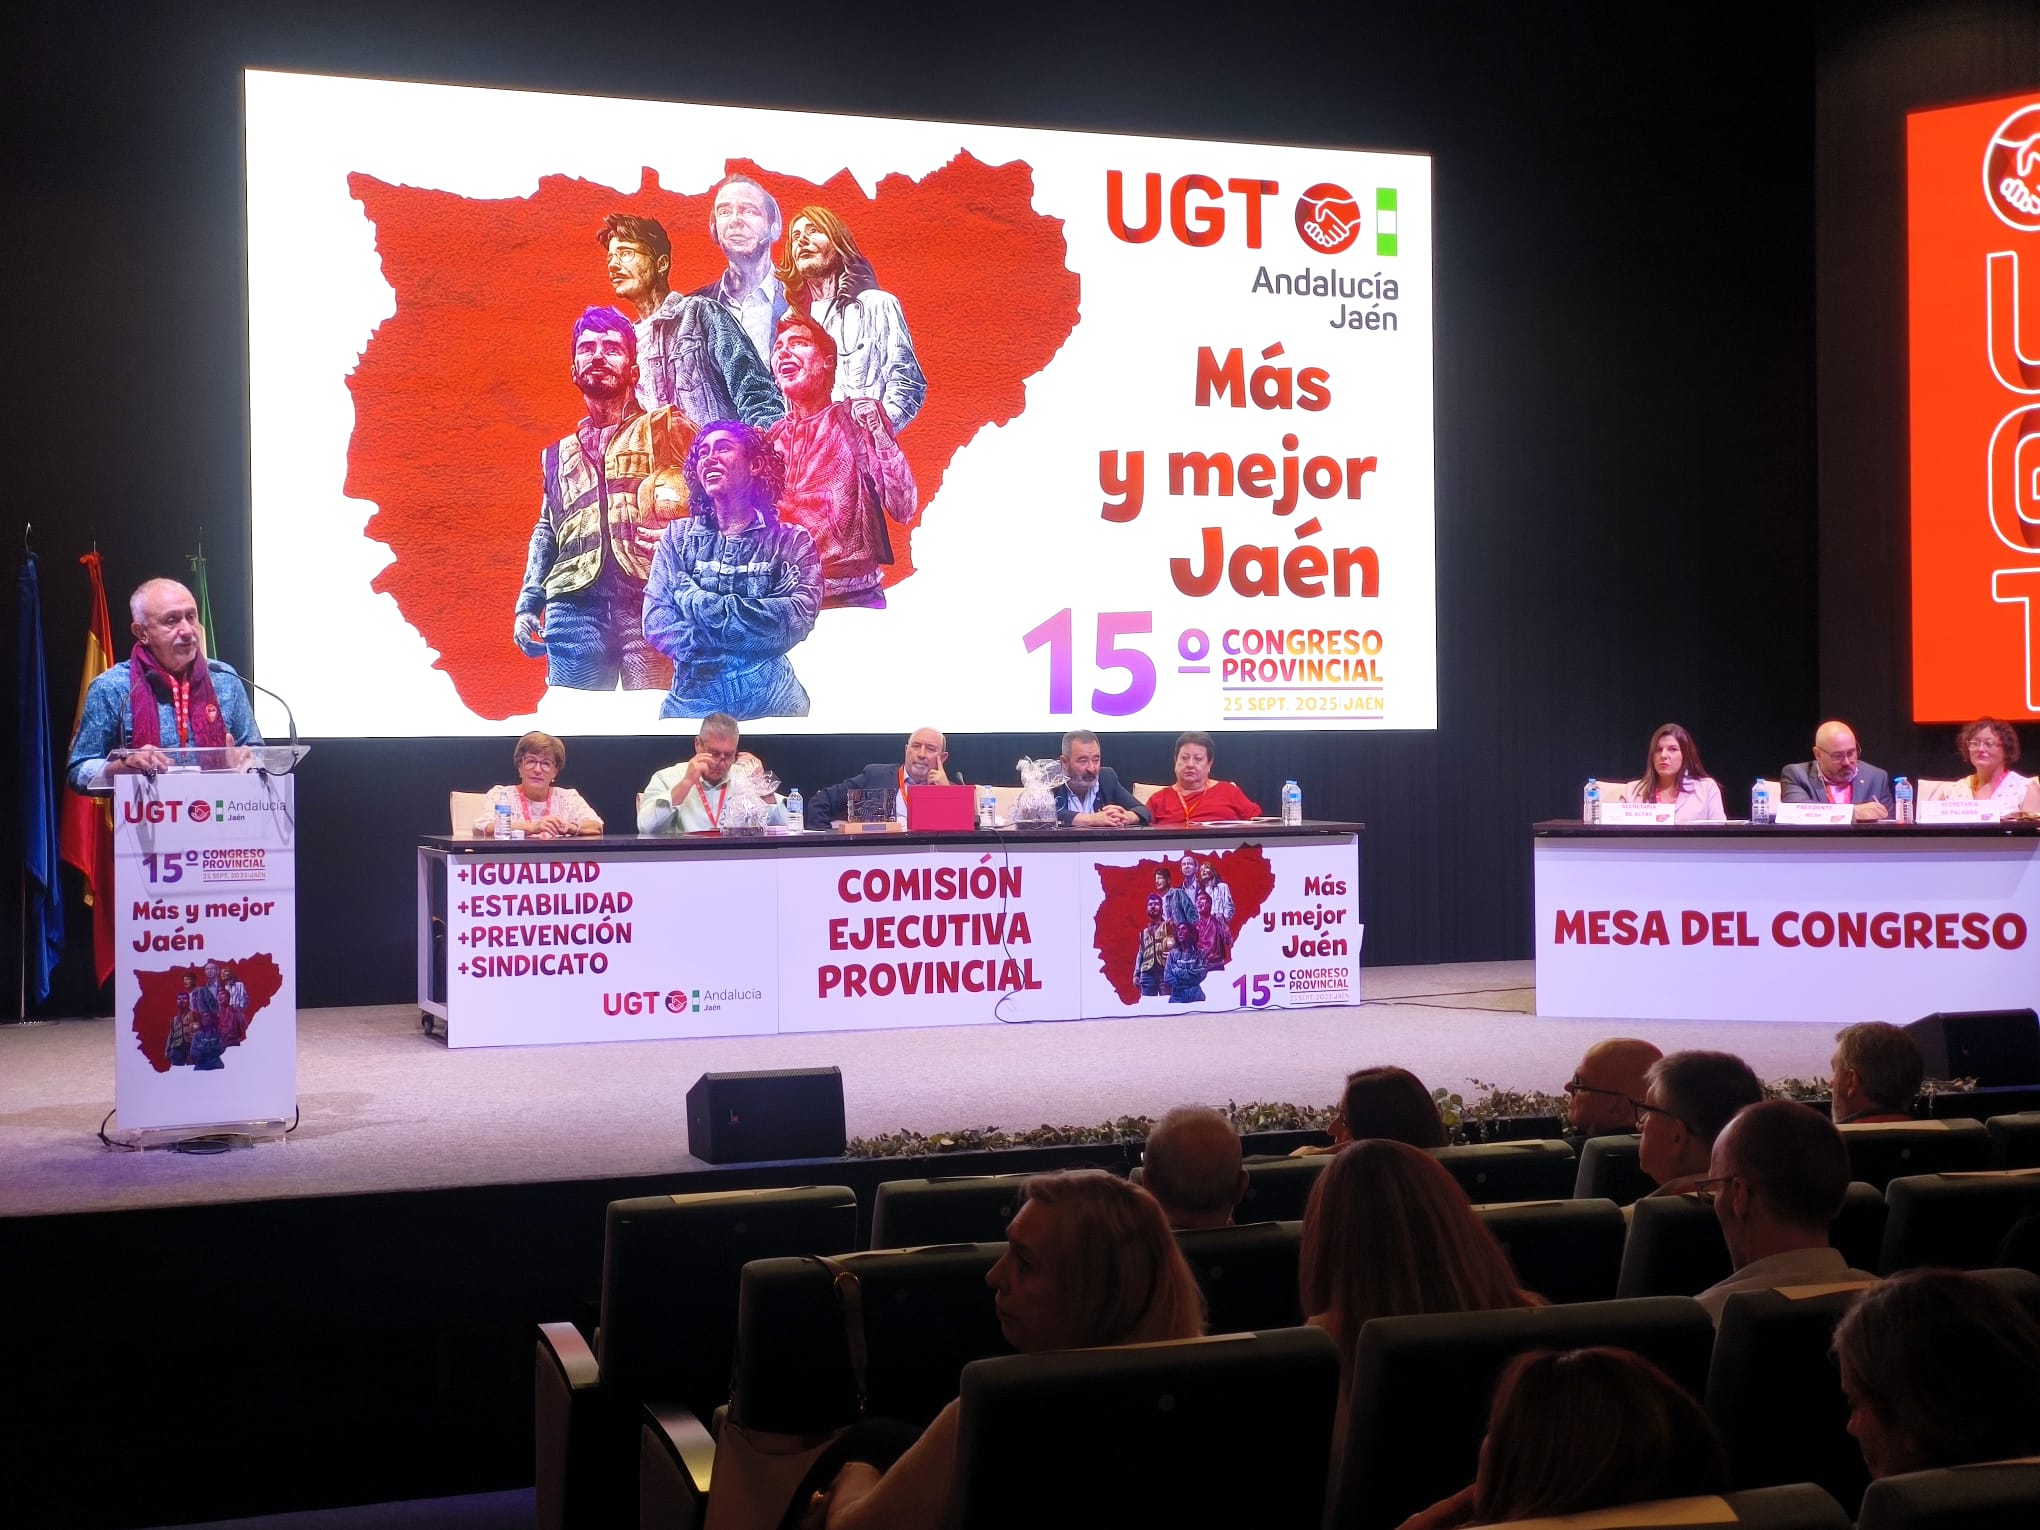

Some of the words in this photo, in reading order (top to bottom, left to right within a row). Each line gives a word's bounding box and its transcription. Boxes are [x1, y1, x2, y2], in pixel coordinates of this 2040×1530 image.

[1107, 170, 1279, 249] UGT
[1252, 266, 1399, 300] Andalucía
[1330, 303, 1398, 331] Jaén
[1195, 341, 1332, 412] Más
[1099, 450, 1144, 523] y
[1169, 433, 1378, 516] mejor
[1170, 517, 1380, 598] Jaén
[1222, 629, 1383, 656] CONGRESO
[1222, 658, 1384, 683] PROVINCIAL
[1223, 697, 1243, 711] 25
[1247, 697, 1290, 711] SEPT.
[124, 800, 183, 824] UGT
[227, 800, 287, 811] Andalucía
[227, 813, 245, 821] Jaén
[202, 859, 266, 869] PROVINCIAL
[203, 848, 265, 859] CONGRESO
[457, 861, 600, 885] +IGUALDAD
[838, 853, 1022, 903] COMISIÓN
[1304, 874, 1347, 896] Más
[133, 899, 179, 920] Más
[186, 902, 199, 924] y
[205, 896, 275, 921] mejor
[457, 891, 633, 917] +ESTABILIDAD
[1263, 911, 1276, 932] y
[1281, 903, 1347, 930] mejor
[1554, 909, 1670, 946] MESA
[1681, 910, 1759, 947] DEL
[1771, 910, 2028, 950] CONGRESO
[133, 926, 204, 952] Jaén
[457, 916, 632, 948] +PREVENCIÓN
[829, 912, 1031, 950] EJECUTIVA
[1282, 930, 1347, 958] Jaén
[457, 952, 609, 978] +SINDICATO
[818, 958, 1042, 998] PROVINCIAL
[1290, 968, 1348, 979] CONGRESO
[703, 989, 762, 1001] Andalucía
[1289, 979, 1349, 990] PROVINCIAL
[603, 991, 660, 1016] UGT
[703, 1003, 721, 1011] Jaén
